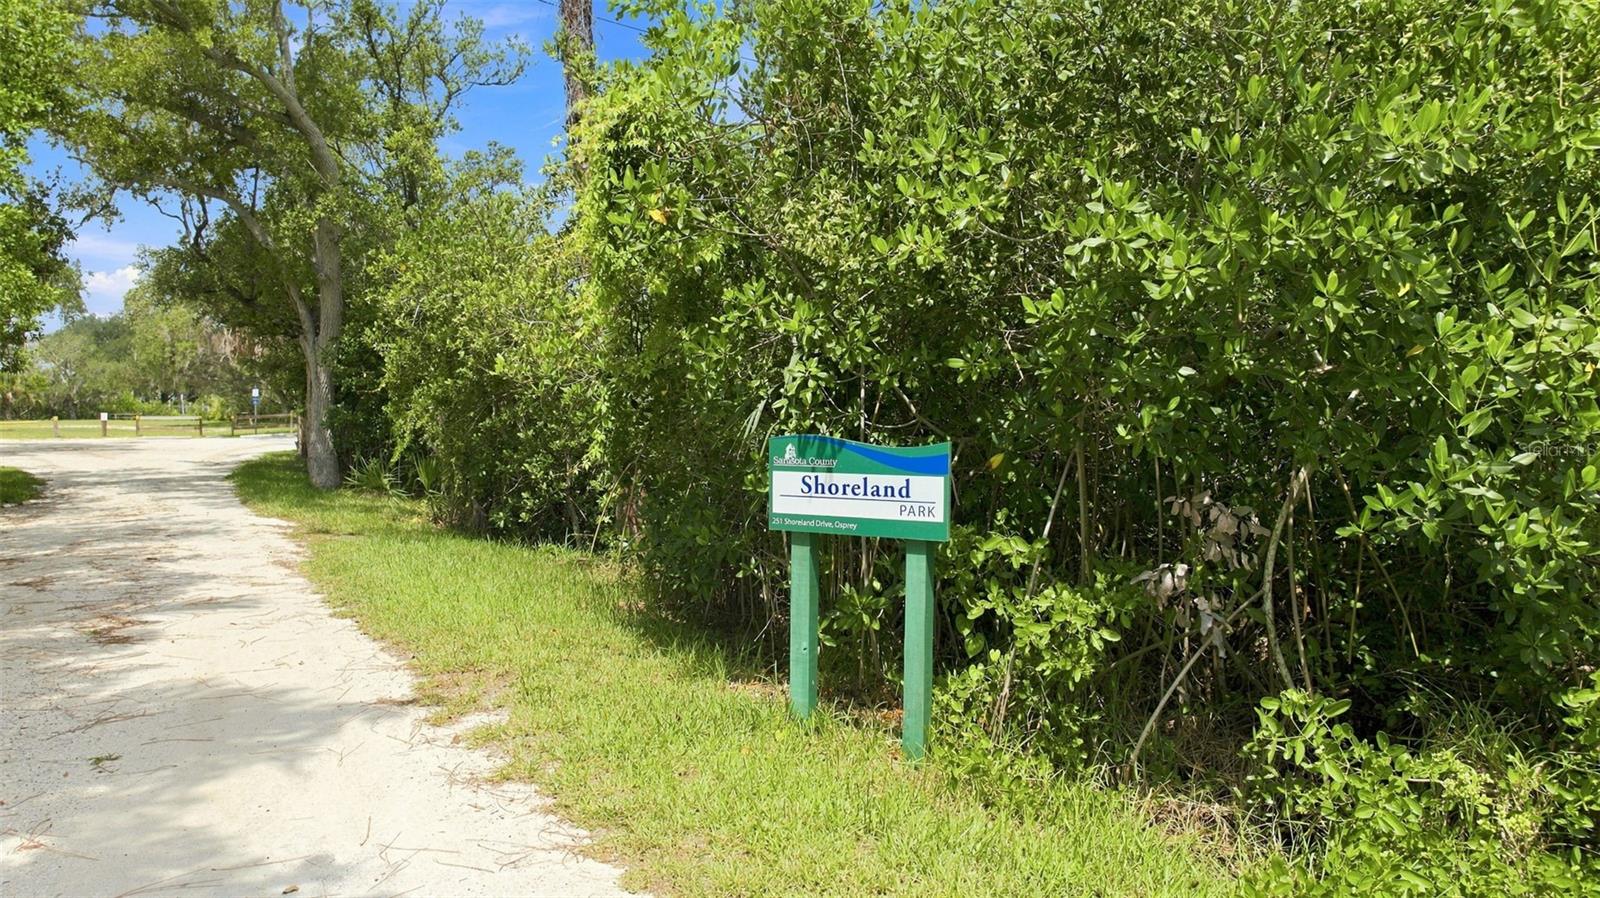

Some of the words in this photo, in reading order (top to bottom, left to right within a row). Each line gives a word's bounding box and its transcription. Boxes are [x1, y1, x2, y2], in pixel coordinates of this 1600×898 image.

[773, 456, 807, 465] Sarasota
[809, 456, 838, 466] County
[800, 475, 911, 499] Shoreland
[899, 504, 935, 518] PARK
[772, 517, 783, 525] 251
[784, 518, 815, 527] Shoreland
[815, 519, 834, 528] Drive,
[835, 520, 858, 530] Osprey
